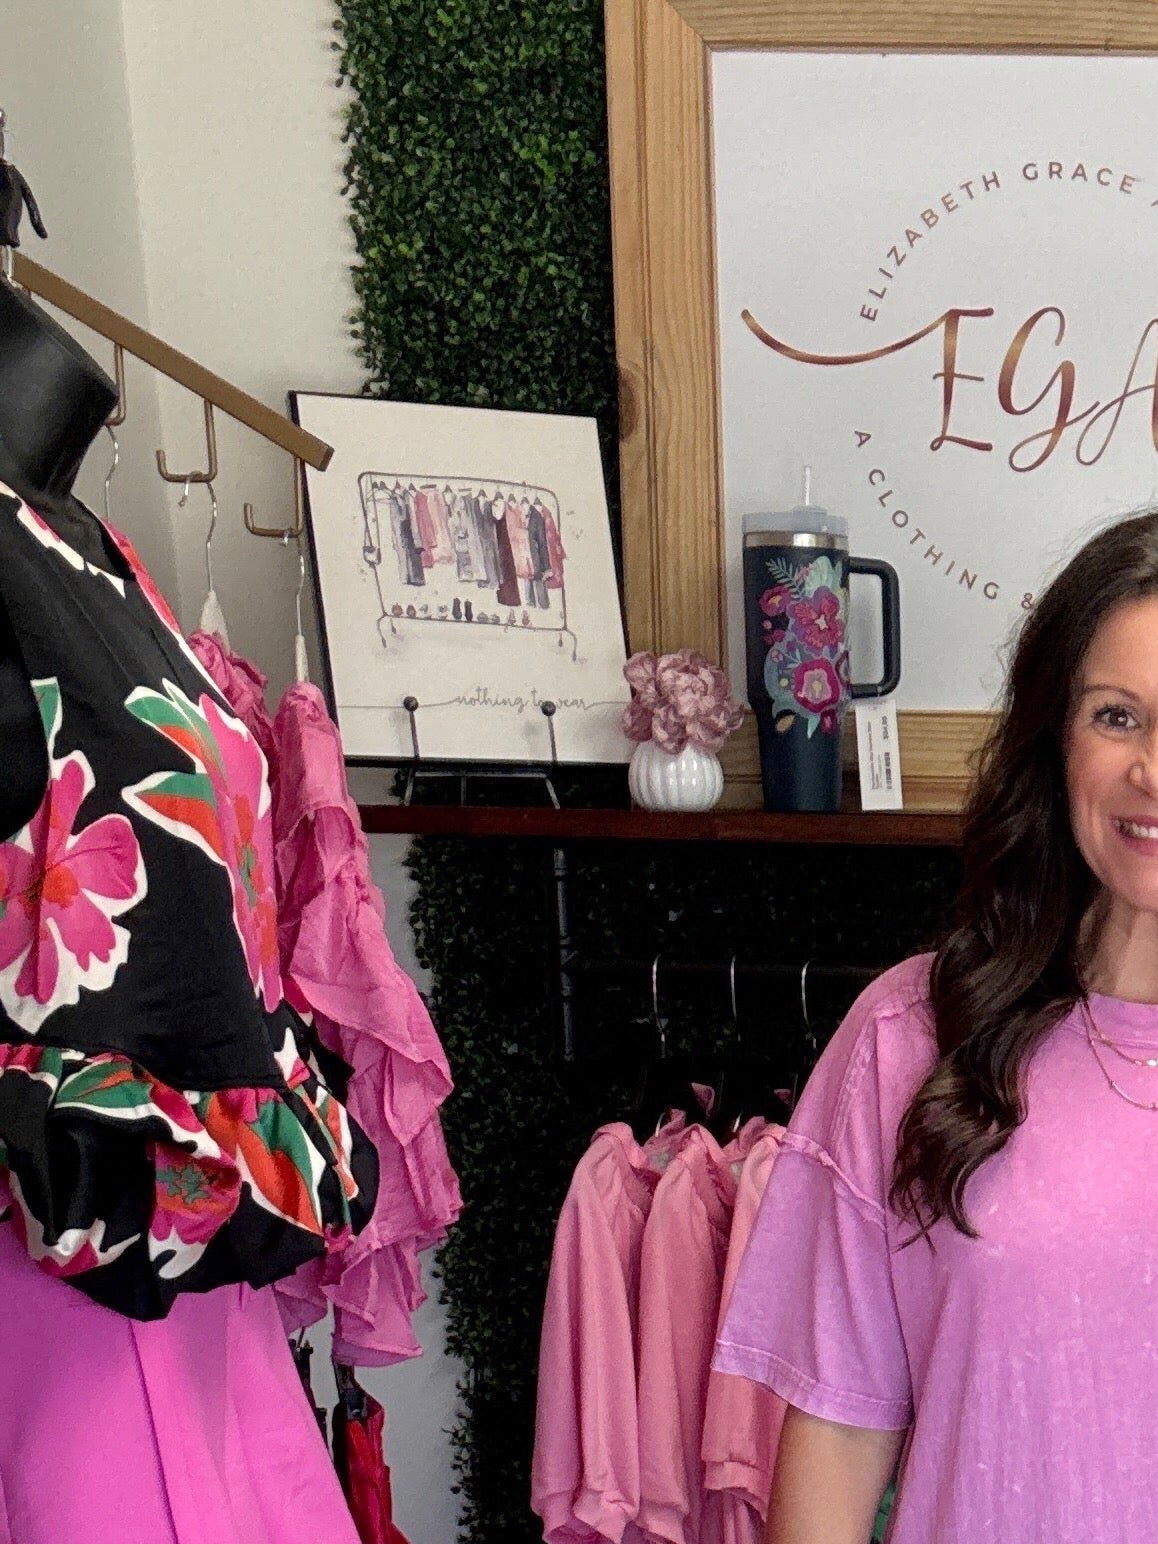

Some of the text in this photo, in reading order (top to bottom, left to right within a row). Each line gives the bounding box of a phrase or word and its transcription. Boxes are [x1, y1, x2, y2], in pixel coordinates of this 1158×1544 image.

[859, 170, 1001, 322] ELIZABETH
[1022, 161, 1137, 195] GRACE
[854, 430, 872, 448] A
[868, 468, 1000, 600] CLOTHING
[456, 686, 527, 713] nothing
